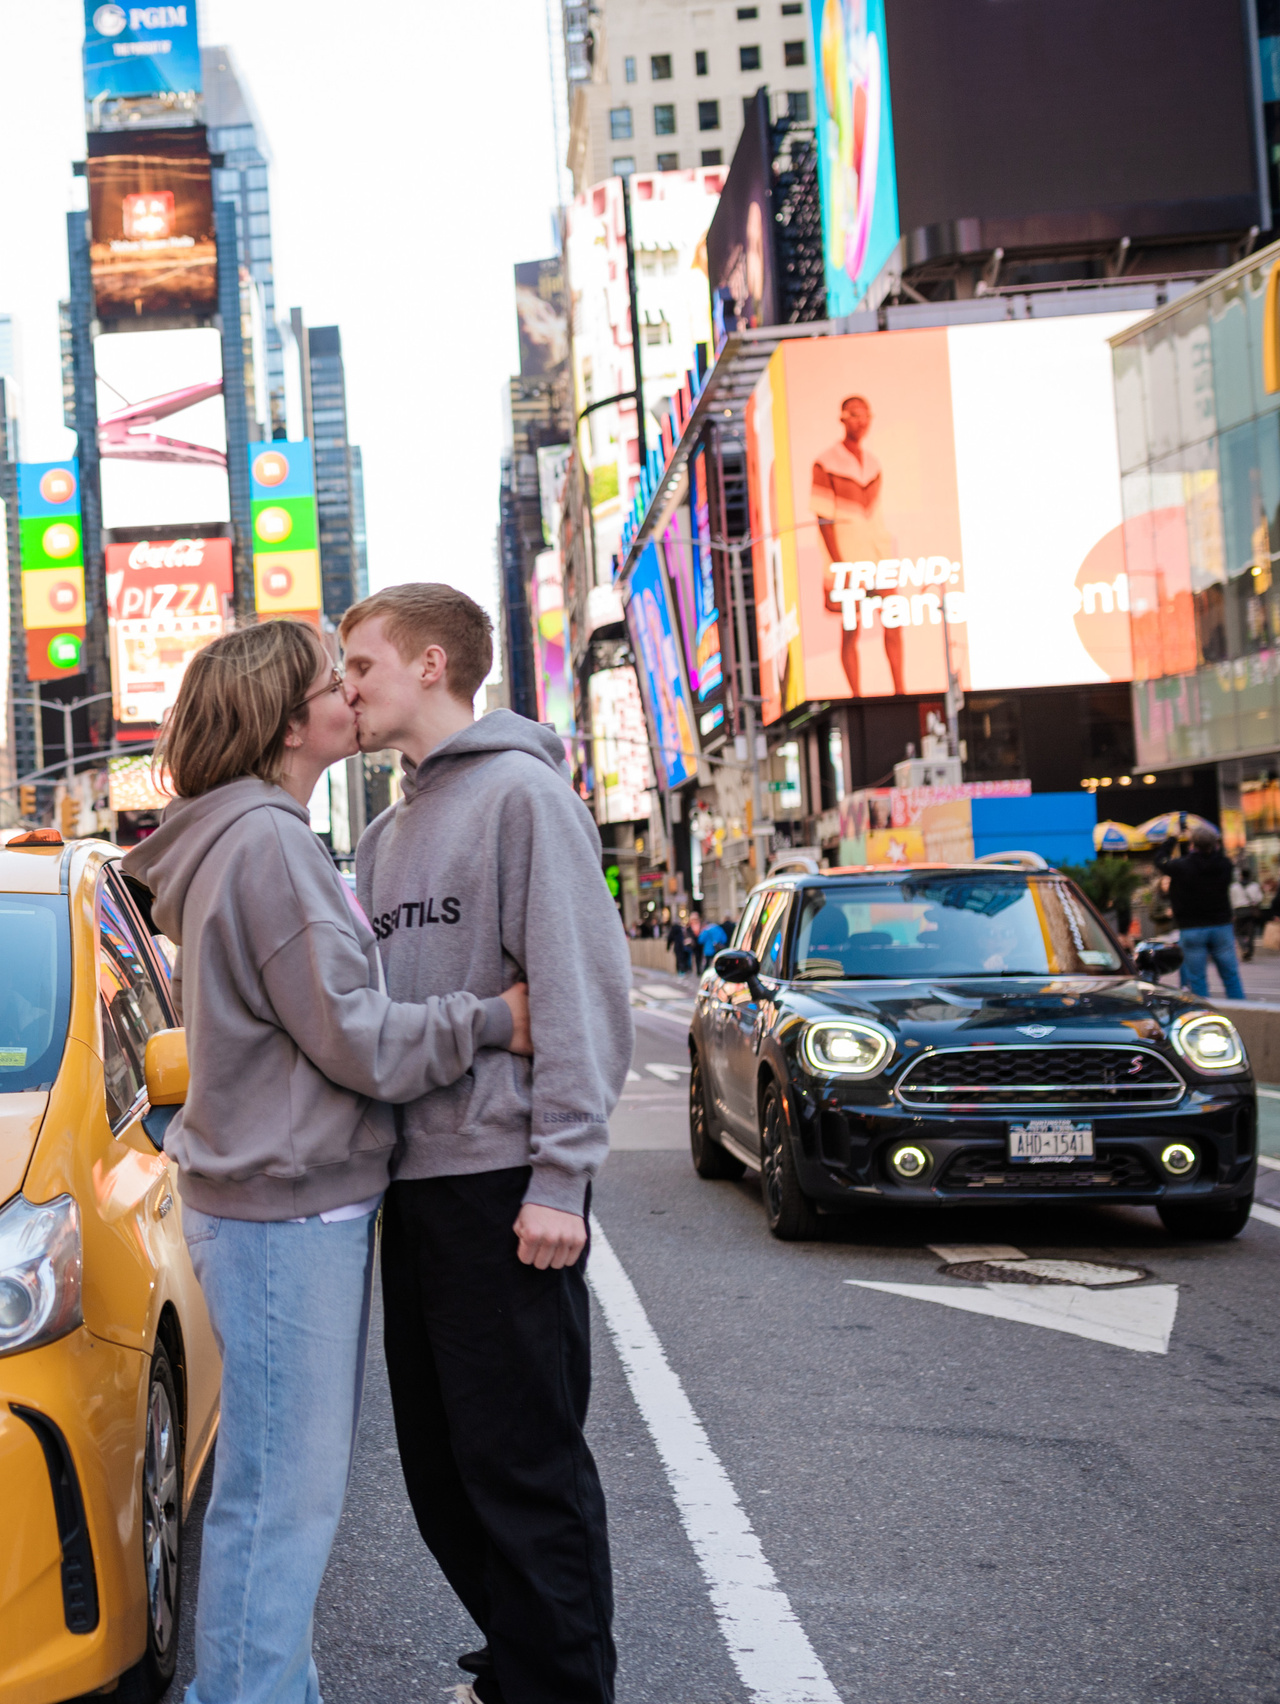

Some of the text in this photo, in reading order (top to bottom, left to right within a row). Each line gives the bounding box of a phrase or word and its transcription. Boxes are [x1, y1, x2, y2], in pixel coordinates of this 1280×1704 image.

[129, 5, 188, 30] PGIM
[830, 556, 961, 590] TREND:
[122, 583, 218, 618] PIZZA
